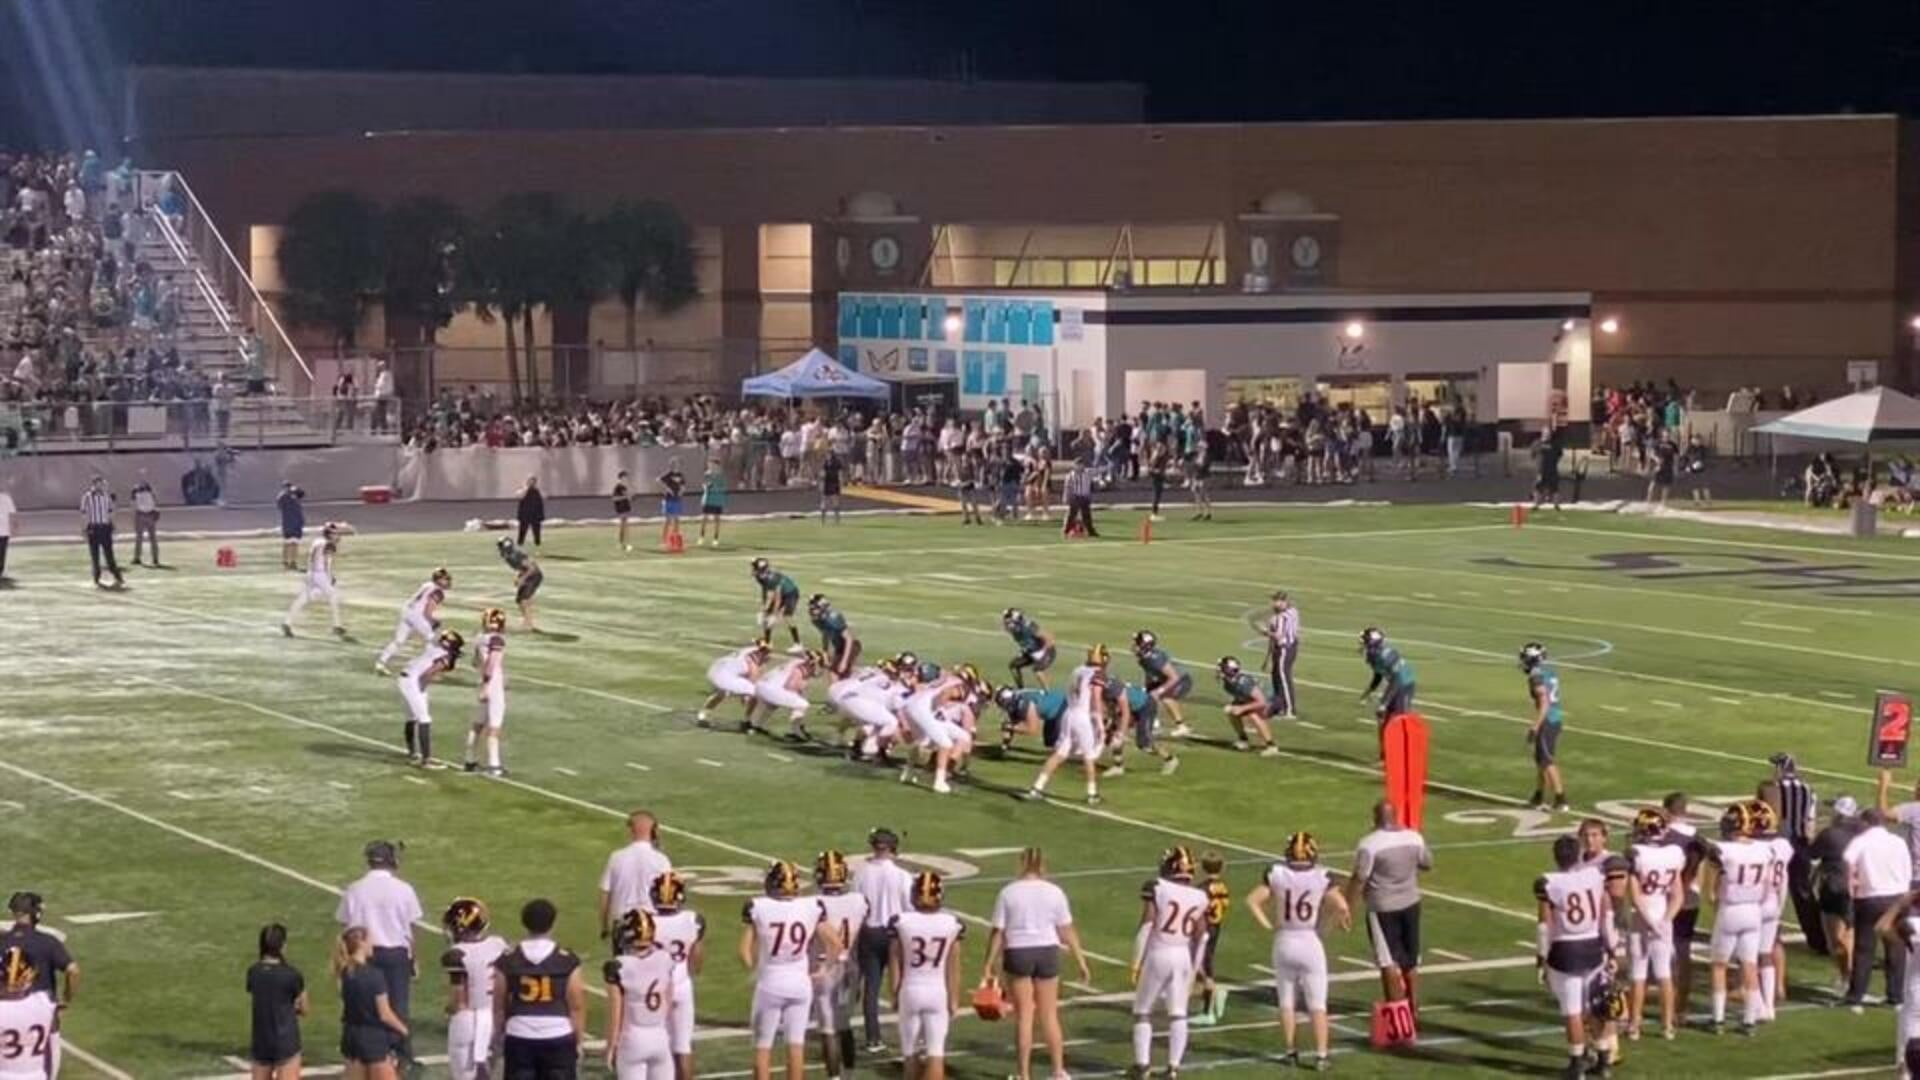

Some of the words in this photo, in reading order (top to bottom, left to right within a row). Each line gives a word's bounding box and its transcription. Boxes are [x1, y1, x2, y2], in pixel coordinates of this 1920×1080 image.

[1879, 703, 1909, 741] 2
[1642, 869, 1678, 896] 87
[1738, 864, 1763, 886] 17
[1162, 900, 1197, 938] 26
[1285, 889, 1313, 922] 16
[1566, 889, 1597, 925] 81
[769, 922, 807, 958] 79
[911, 936, 948, 970] 37
[645, 979, 661, 1012] 6
[1382, 1005, 1413, 1041] 30
[2, 1024, 46, 1060] 32
